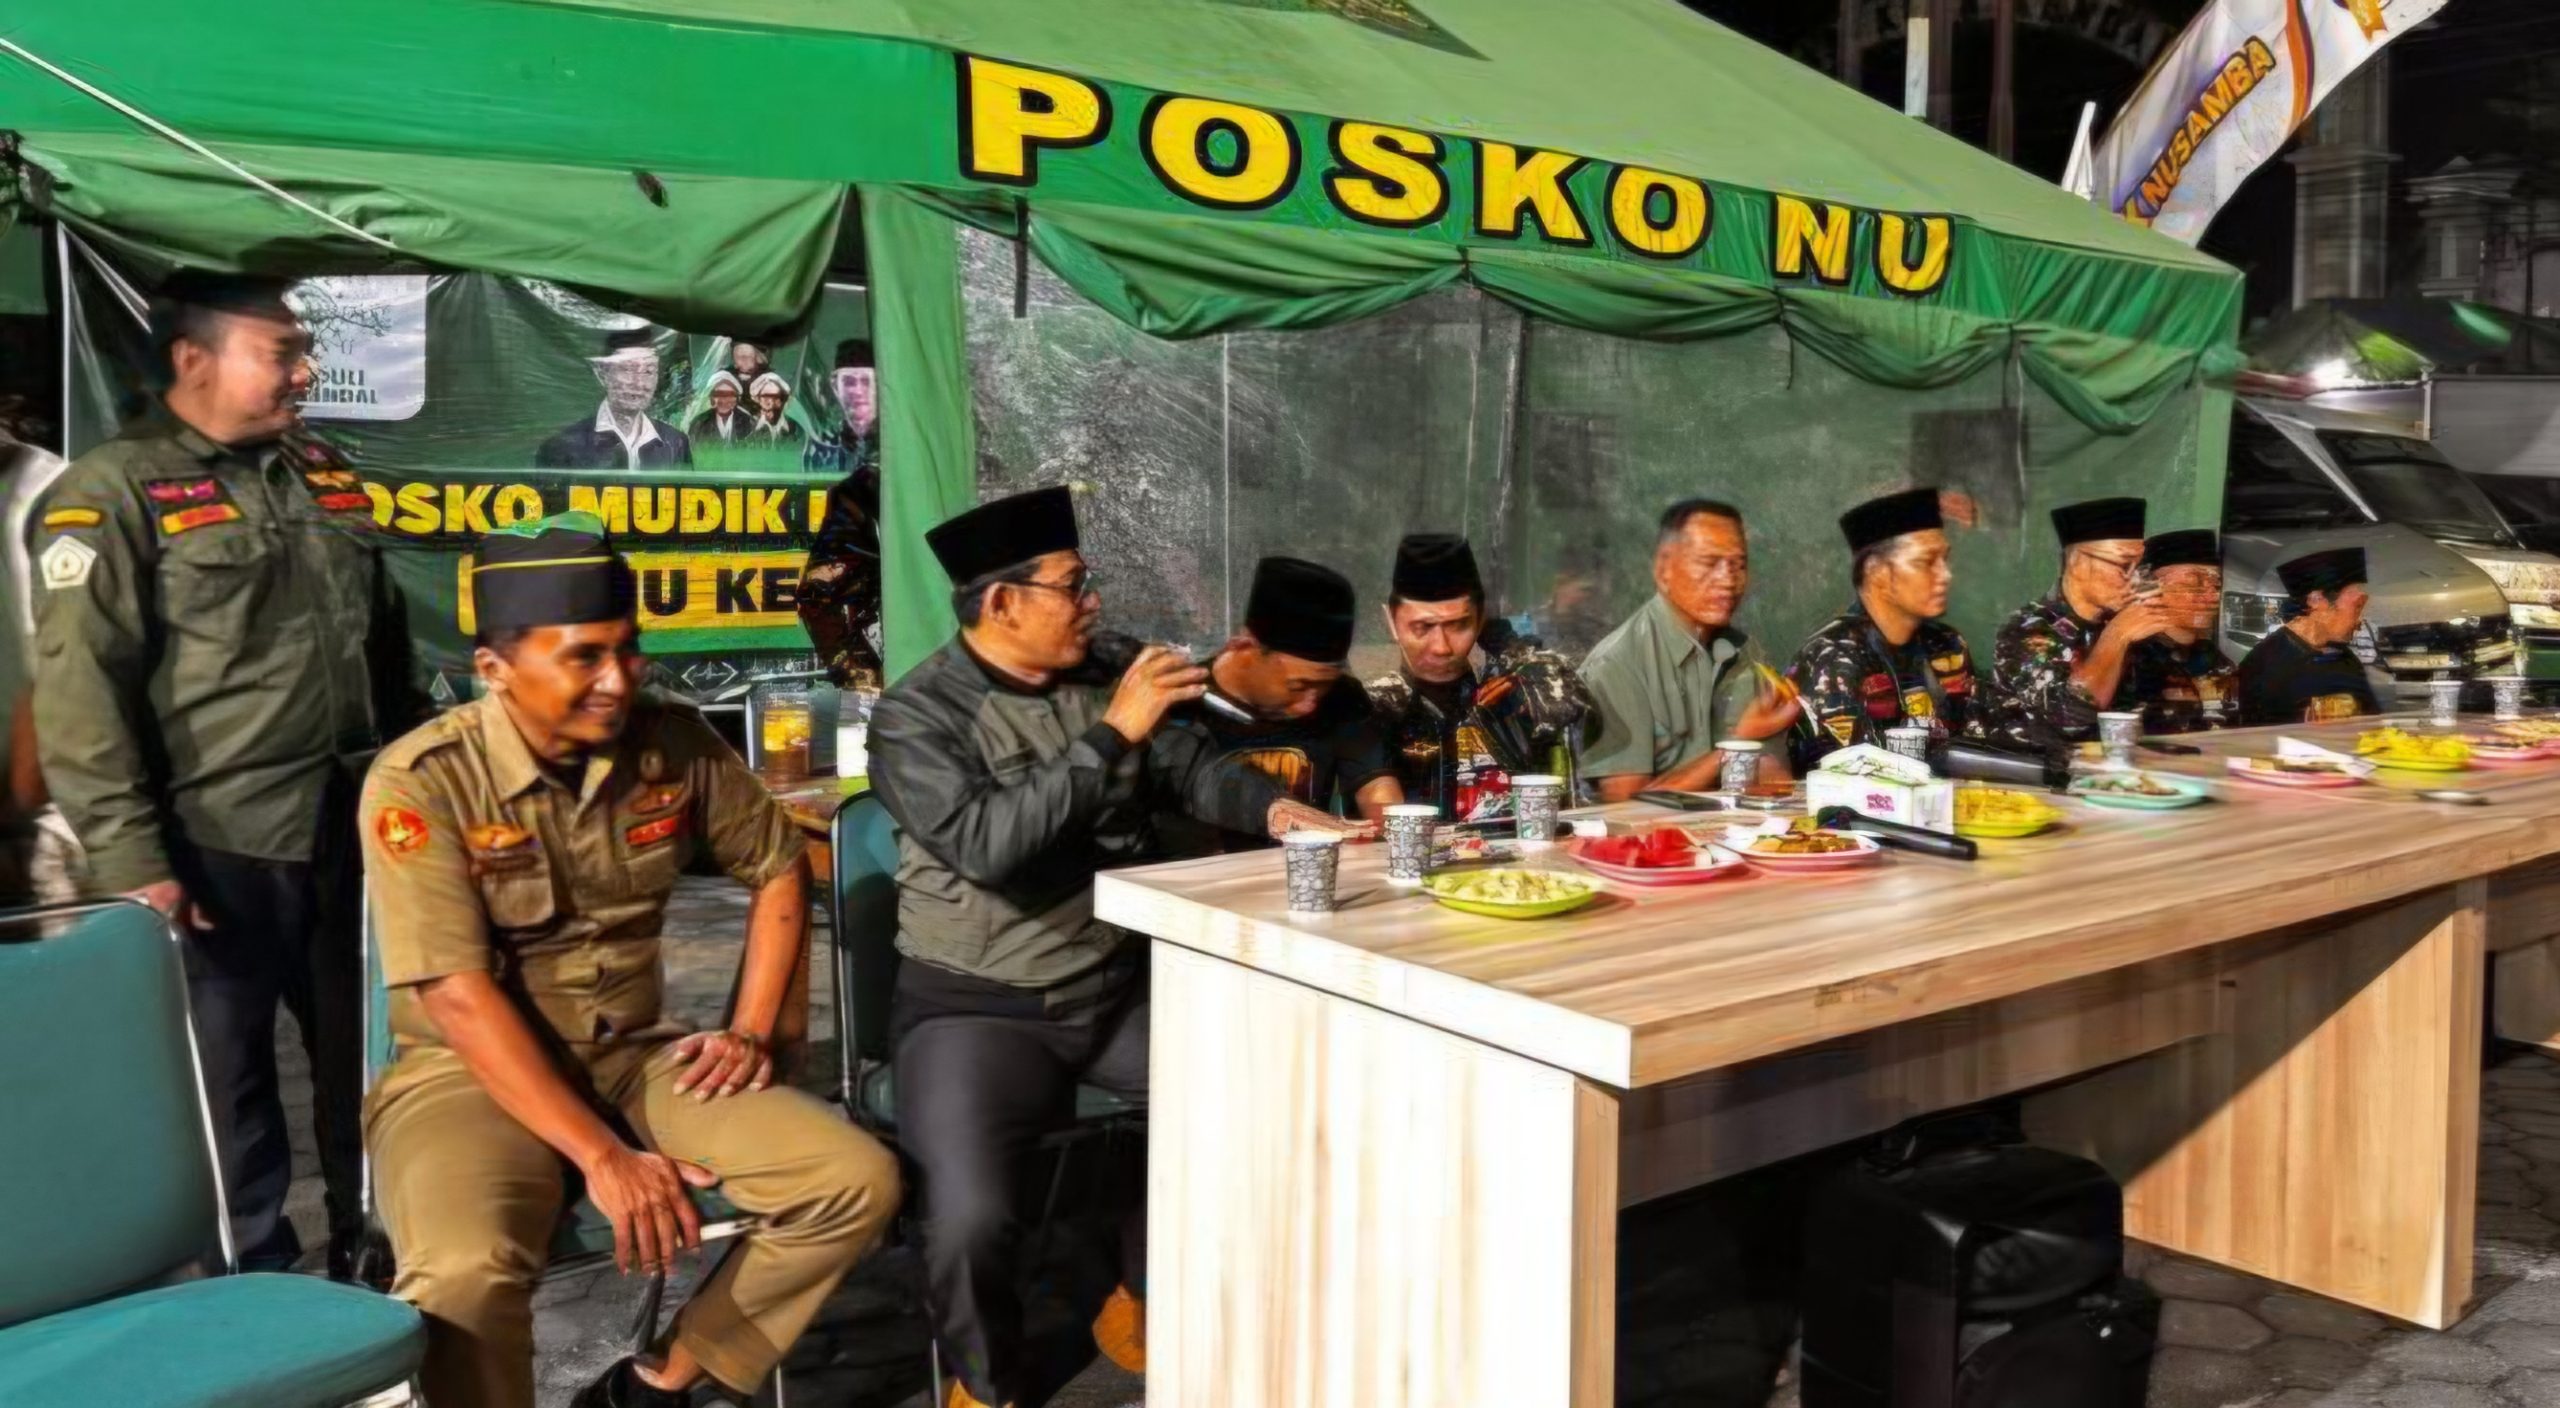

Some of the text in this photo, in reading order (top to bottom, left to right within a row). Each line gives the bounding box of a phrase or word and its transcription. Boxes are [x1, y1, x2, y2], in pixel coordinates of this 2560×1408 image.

[957, 54, 1954, 296] POSKO NU
[2139, 35, 2277, 209] NUSAMBA
[363, 482, 543, 534] OSKO
[569, 484, 788, 534] MUDIK
[716, 567, 802, 614] KE
